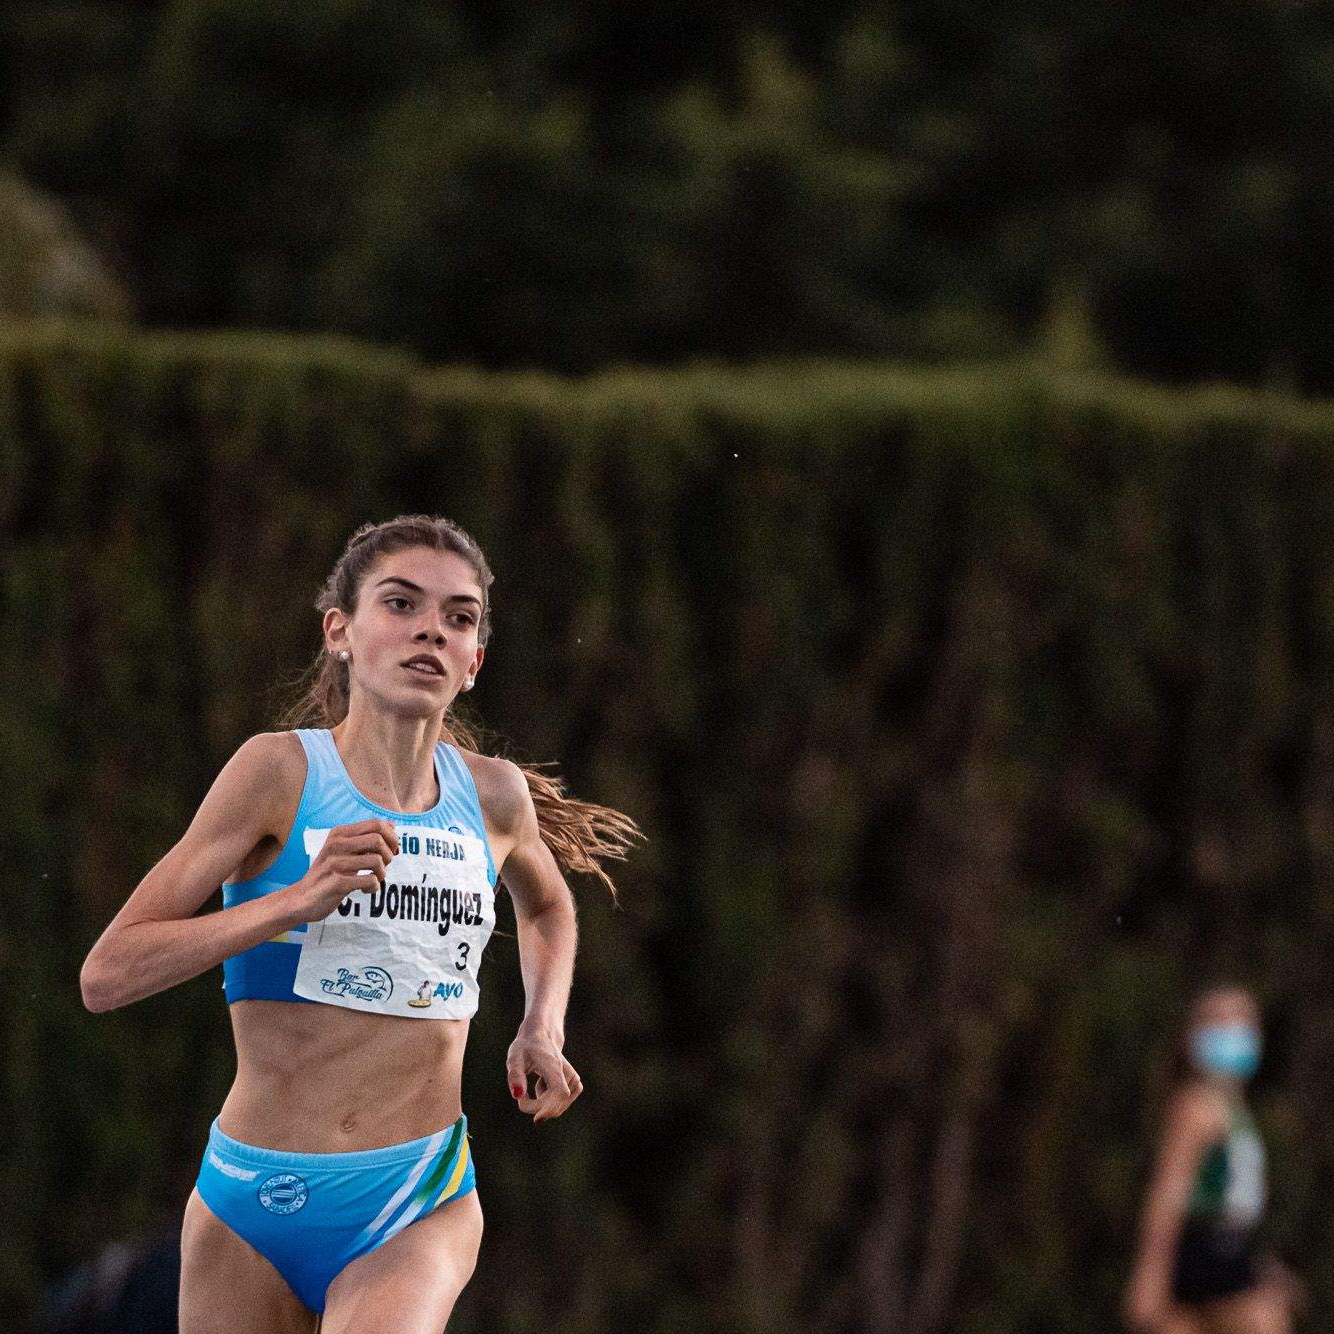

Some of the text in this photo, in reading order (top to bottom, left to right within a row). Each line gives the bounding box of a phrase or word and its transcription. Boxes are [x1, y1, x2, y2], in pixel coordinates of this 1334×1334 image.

[398, 833, 466, 861] ÍO NERJA
[369, 873, 484, 936] Domínguez
[455, 942, 471, 971] 3
